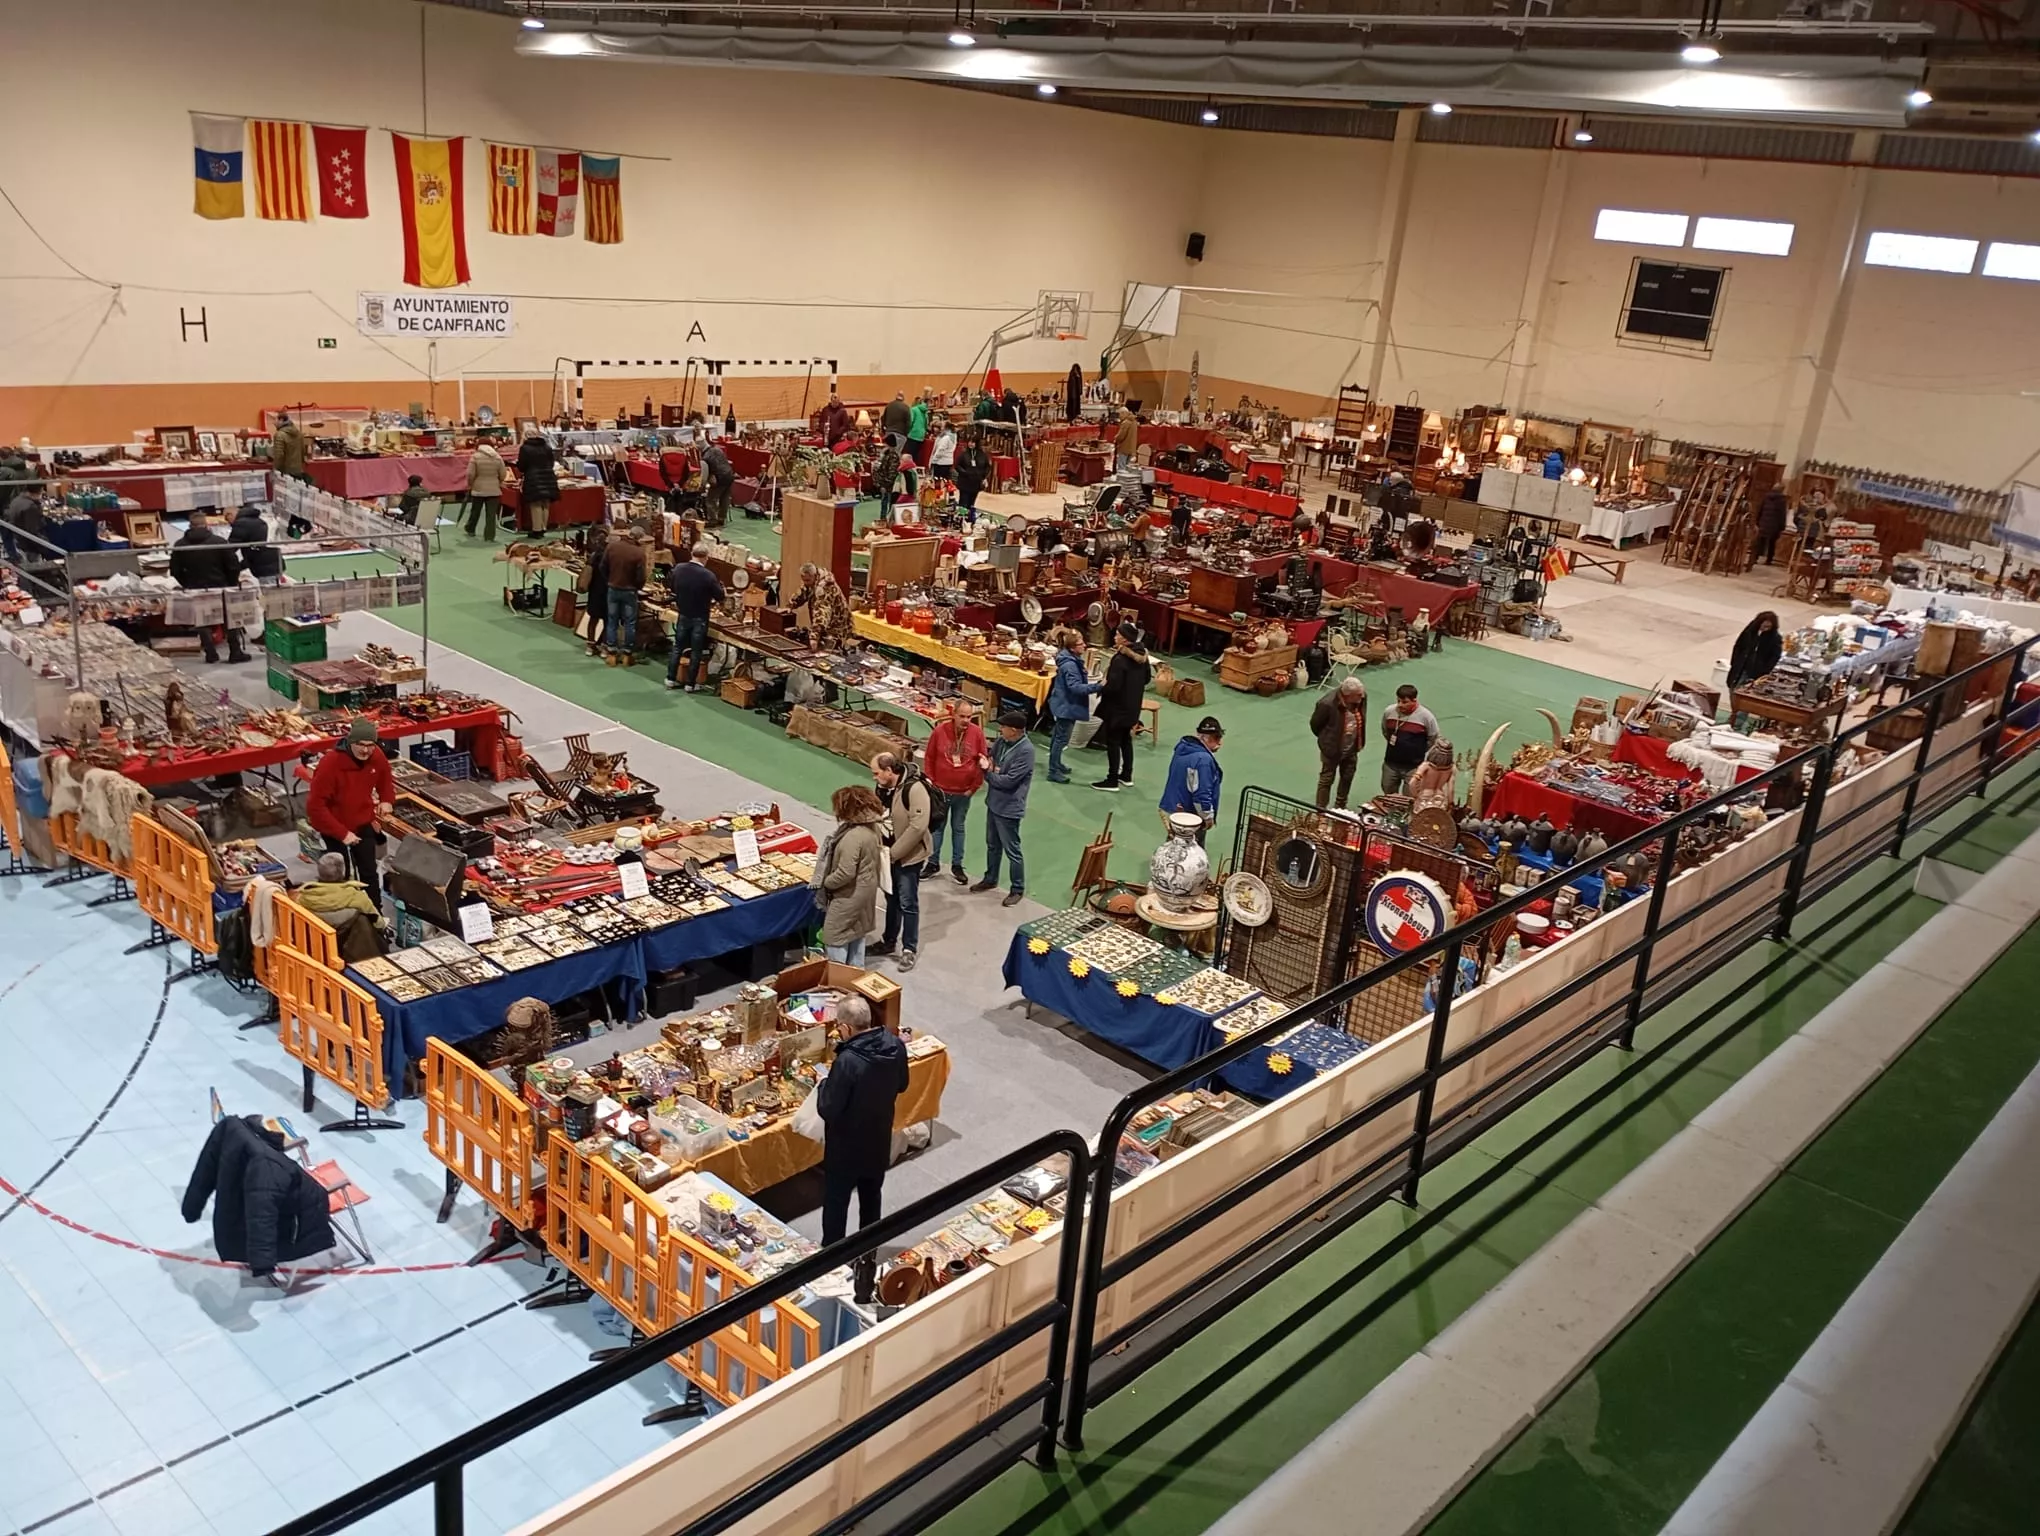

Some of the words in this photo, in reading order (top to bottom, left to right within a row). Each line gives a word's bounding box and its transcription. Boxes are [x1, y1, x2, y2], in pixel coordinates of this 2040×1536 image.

[393, 298, 509, 314] AYUNTAMIENTO
[180, 306, 208, 343] H
[398, 317, 419, 331] DE
[422, 318, 506, 332] CANFRANC
[686, 320, 706, 343] A
[1380, 896, 1430, 938] Kronenbourg
